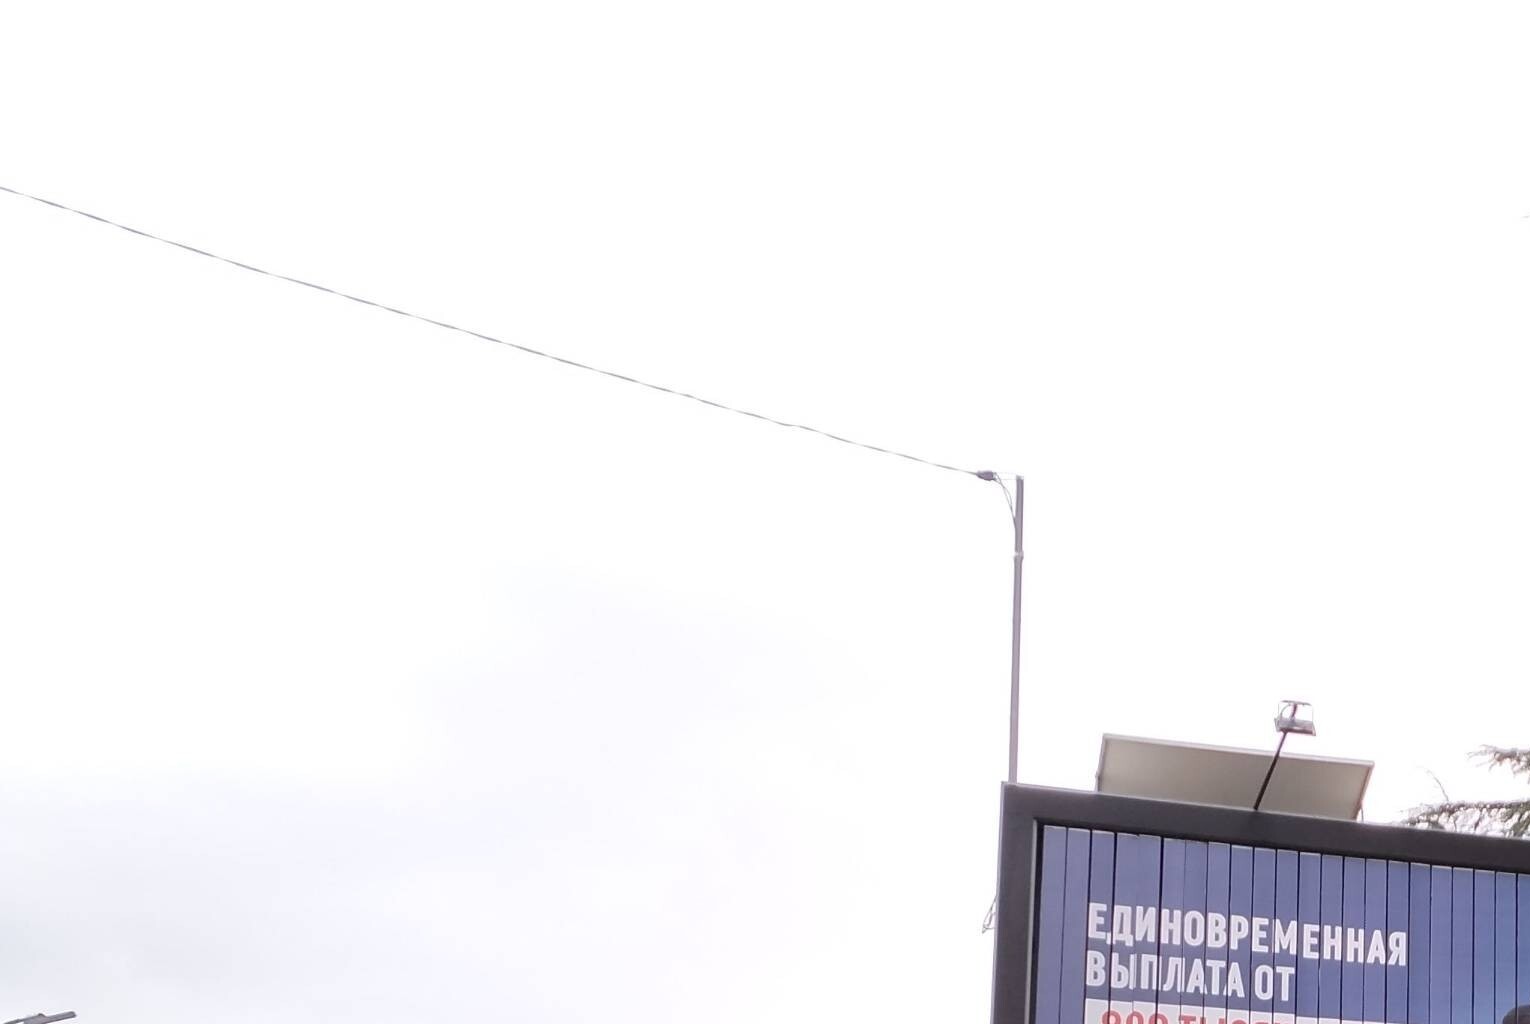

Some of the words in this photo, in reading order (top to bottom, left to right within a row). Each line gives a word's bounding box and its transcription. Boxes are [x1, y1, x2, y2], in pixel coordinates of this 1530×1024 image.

[1087, 902, 1408, 967] ЕДИНОВРЕМЕННАЯ
[1085, 950, 1245, 998] ВЫПЛАТА
[1254, 965, 1296, 1002] ОТ
